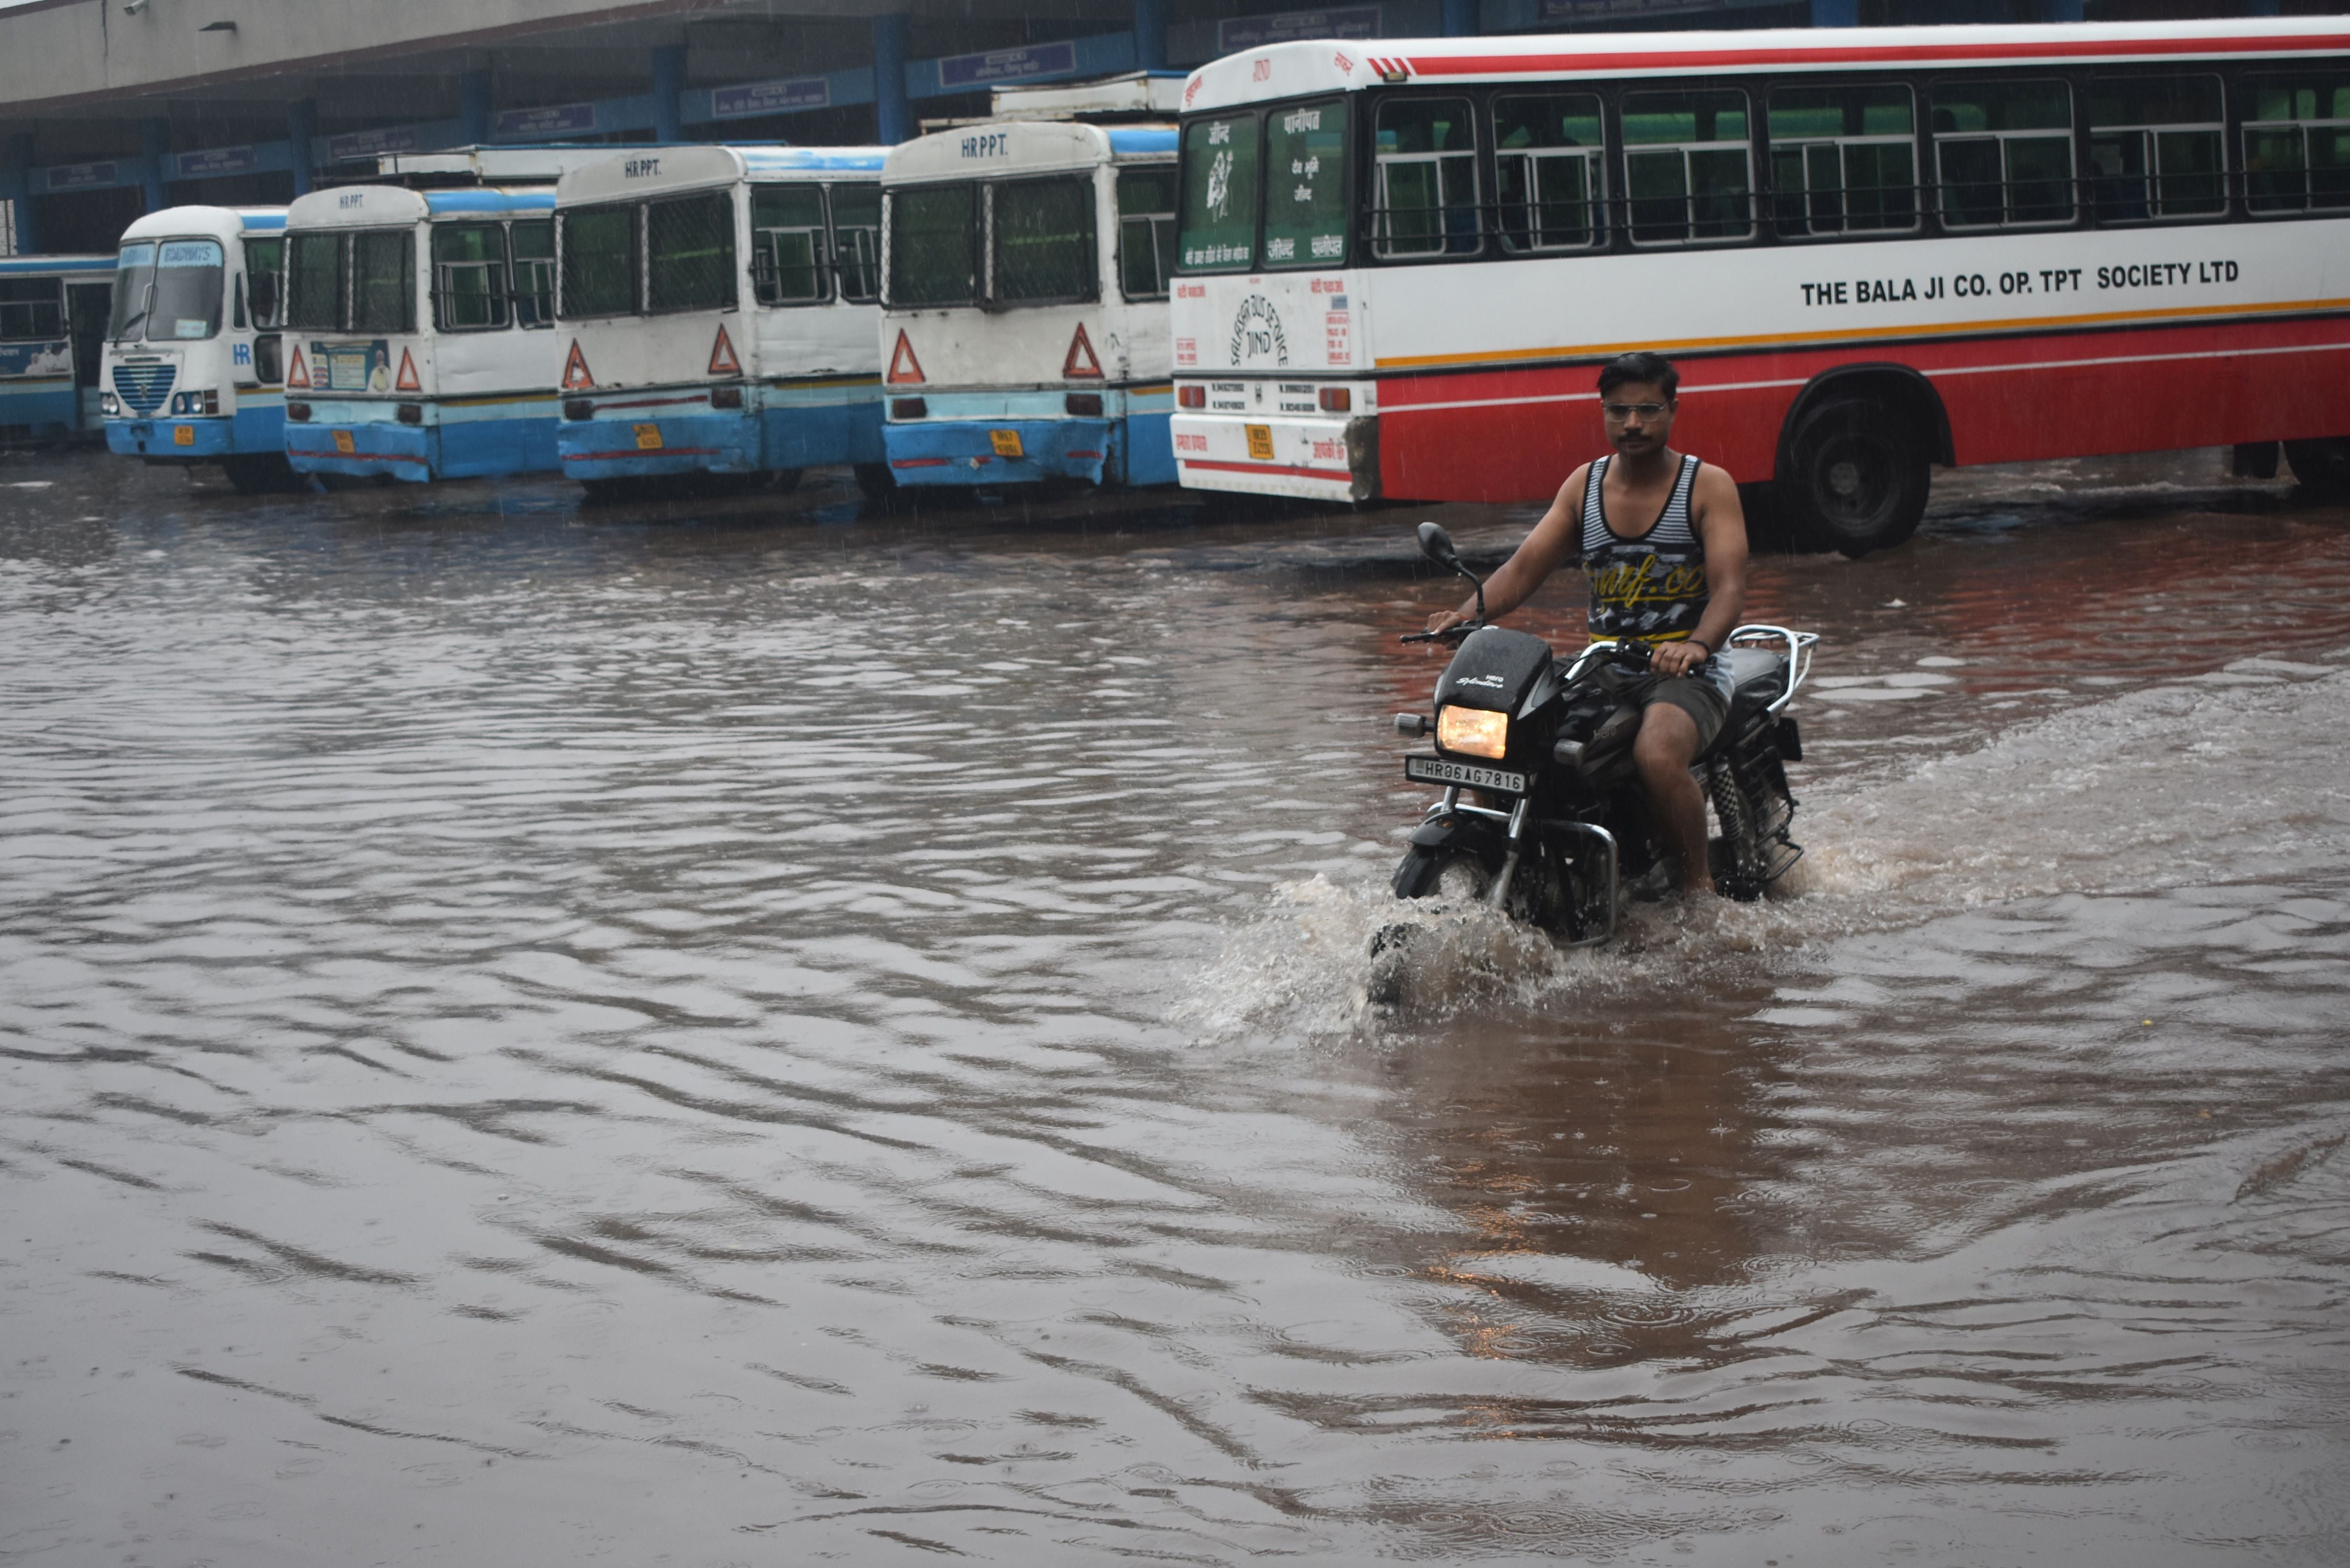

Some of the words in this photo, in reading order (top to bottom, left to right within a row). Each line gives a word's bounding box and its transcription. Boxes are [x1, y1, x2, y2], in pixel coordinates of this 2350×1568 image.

[1801, 282, 1847, 306] THE
[1856, 279, 1917, 303] BALA
[1924, 276, 1944, 299] JI
[1954, 274, 1991, 297] CO.
[1999, 272, 2032, 294] OP.
[2040, 269, 2082, 292] TPT
[2098, 262, 2191, 289] SOCIETY
[2199, 260, 2239, 284] LTD
[1247, 331, 1271, 359] JIND
[1265, 303, 1288, 366] SERVICE
[233, 343, 251, 365] HR
[1425, 762, 1520, 790] HR06AG7816
